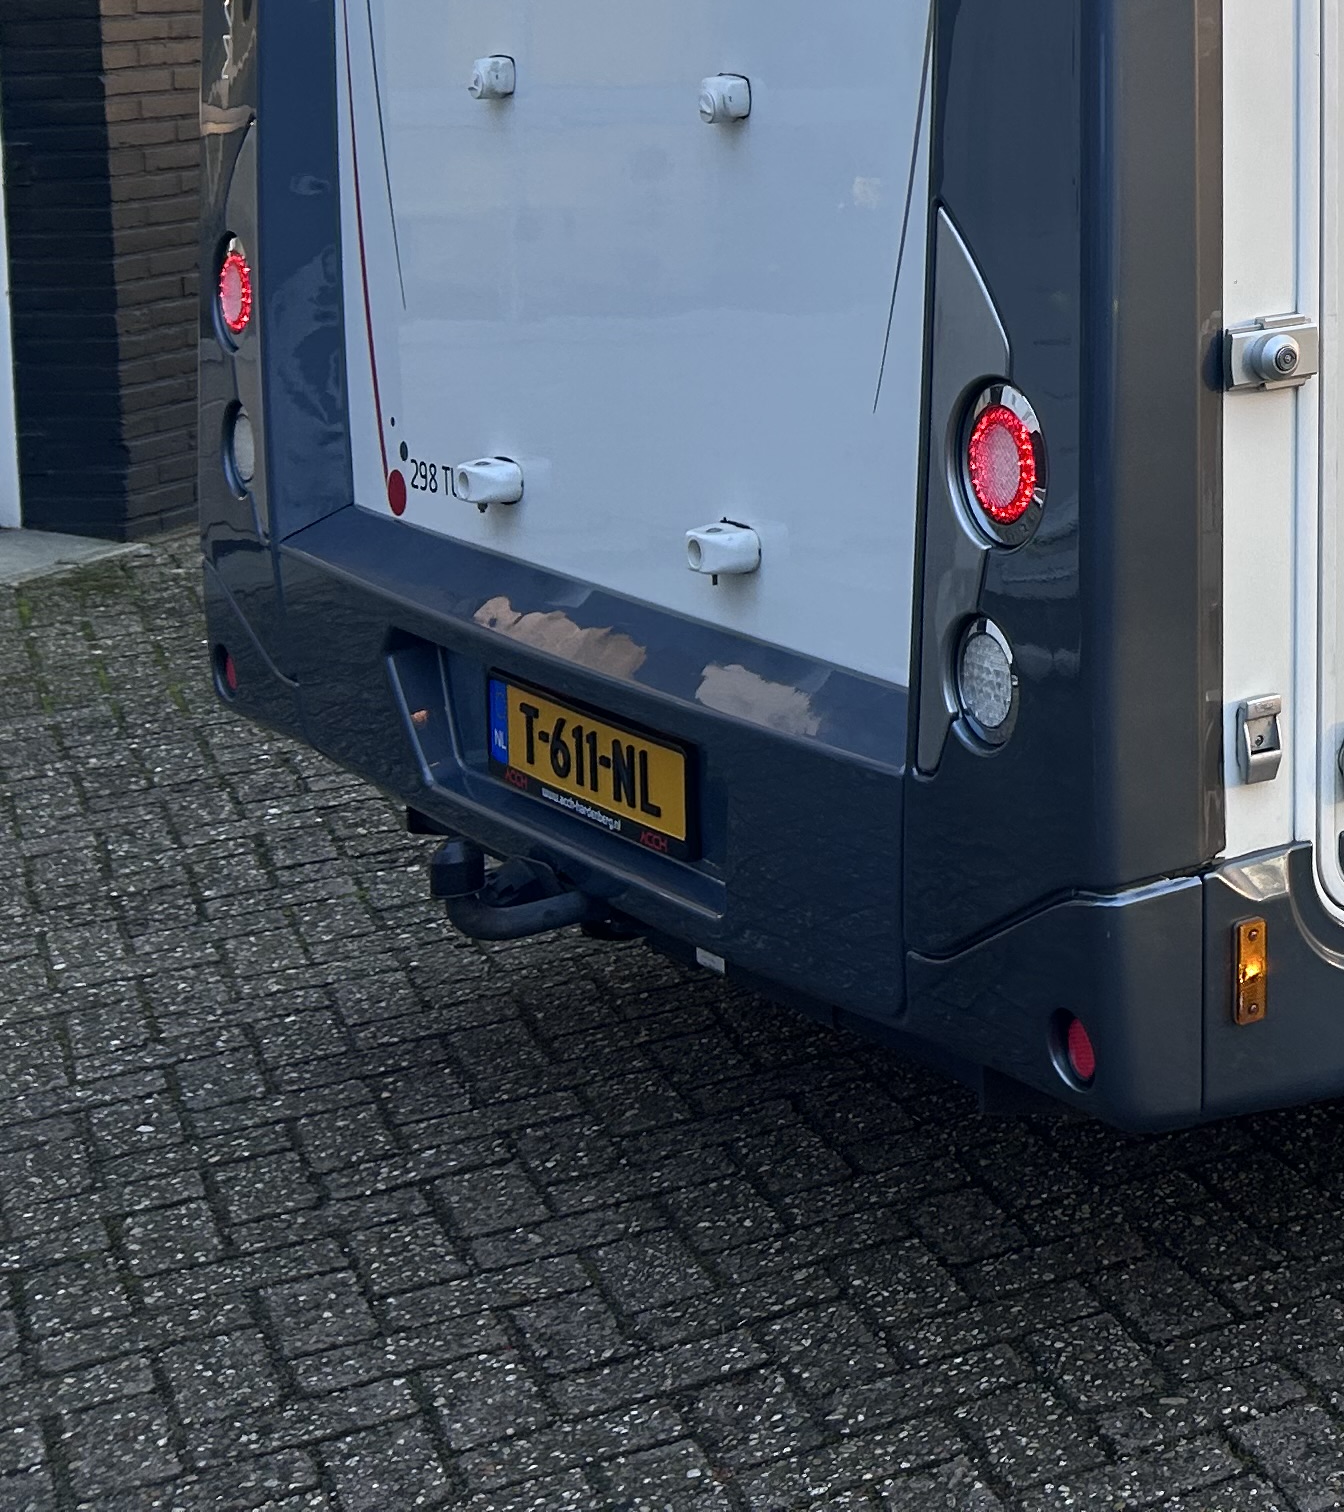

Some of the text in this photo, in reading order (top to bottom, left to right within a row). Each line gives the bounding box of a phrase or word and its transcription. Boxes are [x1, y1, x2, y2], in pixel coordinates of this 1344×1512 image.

[410, 458, 458, 498] 298 TL
[494, 727, 507, 751] NL
[519, 702, 662, 819] T-611-NL
